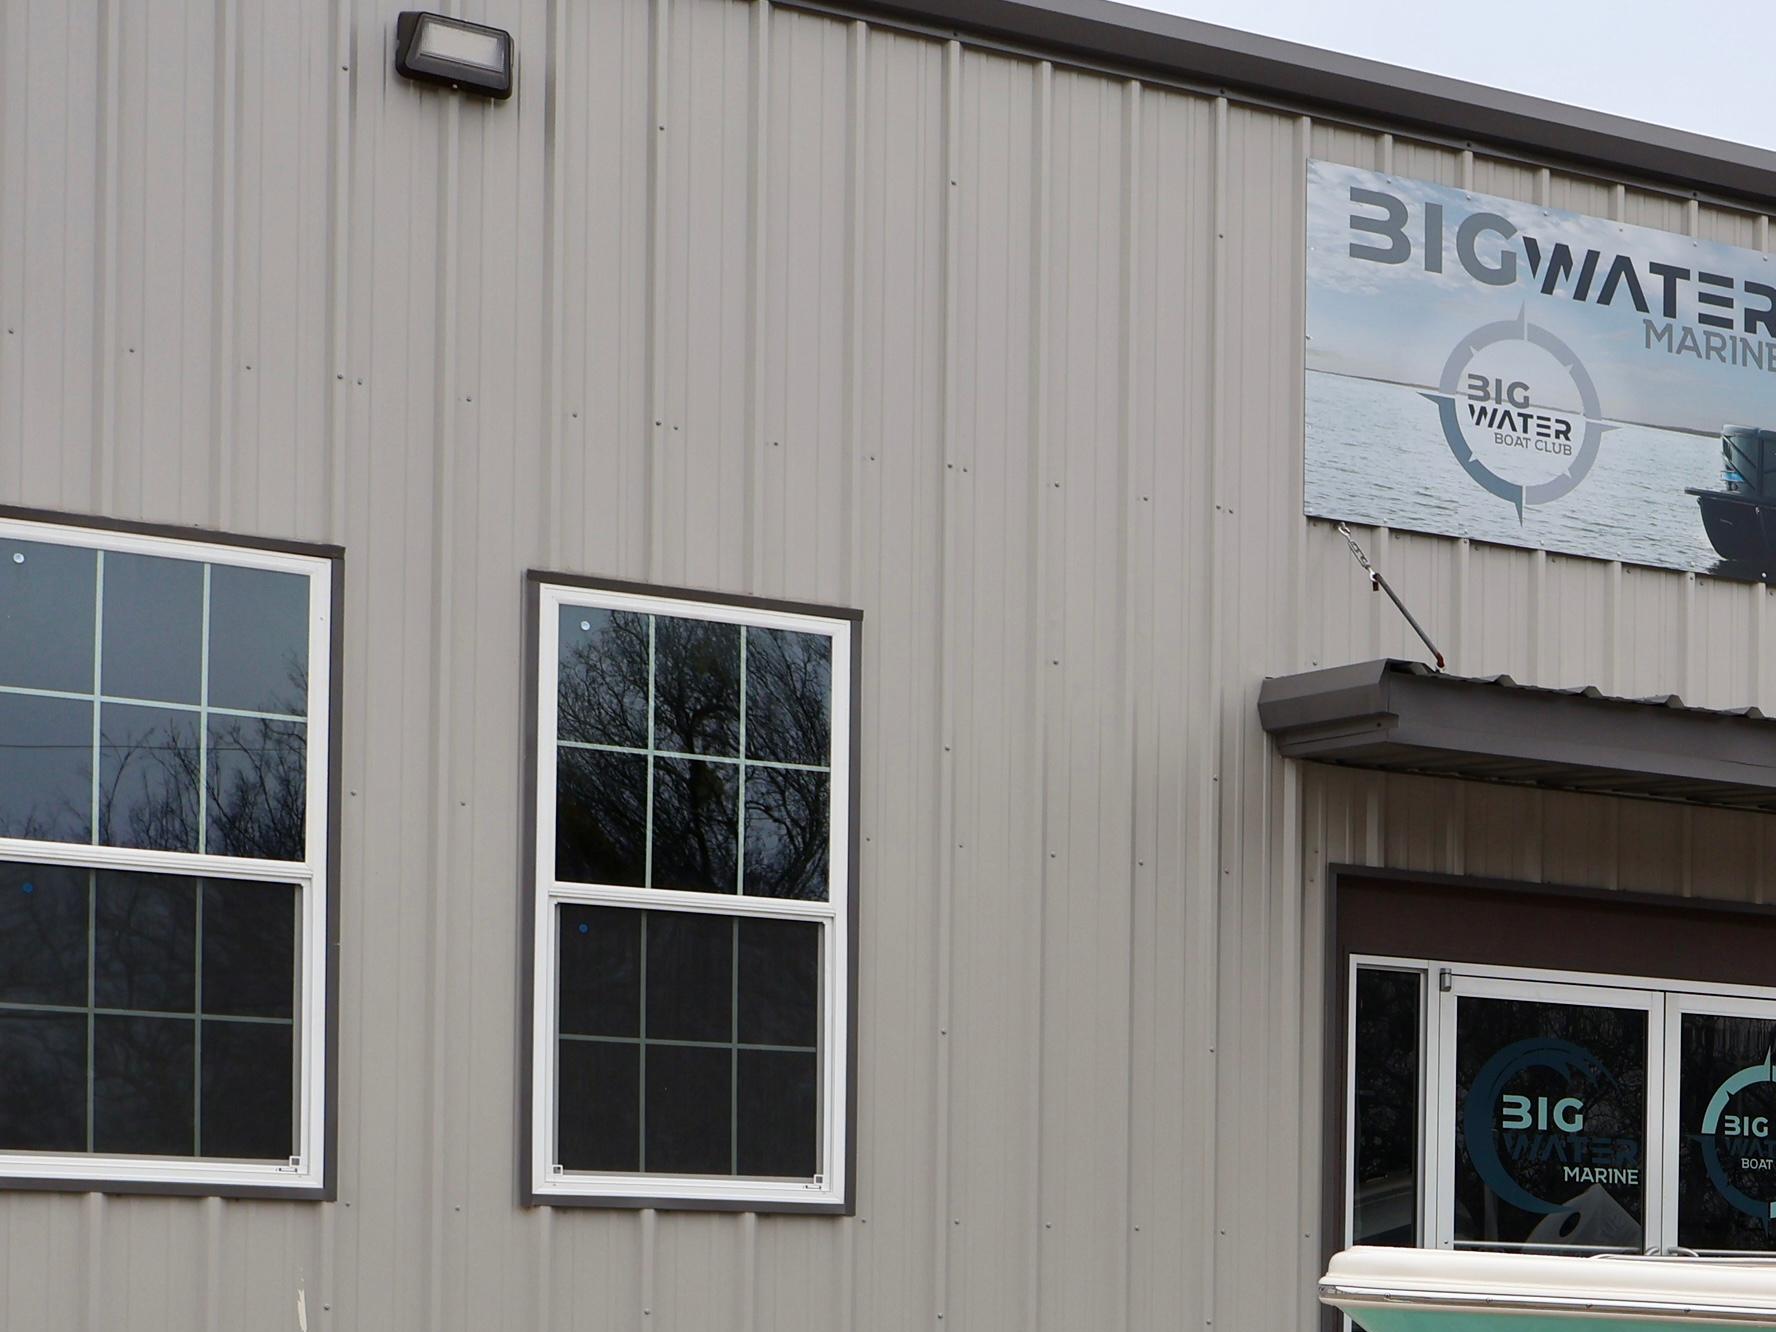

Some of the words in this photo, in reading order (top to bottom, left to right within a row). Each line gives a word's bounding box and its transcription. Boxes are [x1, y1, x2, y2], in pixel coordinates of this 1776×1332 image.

[1467, 372, 1530, 410] BIG
[1467, 402, 1572, 442] WATER
[1494, 432, 1532, 449] BOAT
[1534, 439, 1573, 456] CLUB
[1502, 1094, 1584, 1133] BIG
[1724, 1114, 1769, 1138] BIG
[1503, 1133, 1640, 1168] WATER
[1741, 1157, 1773, 1170] BOAT
[1563, 1166, 1639, 1185] MARINE
